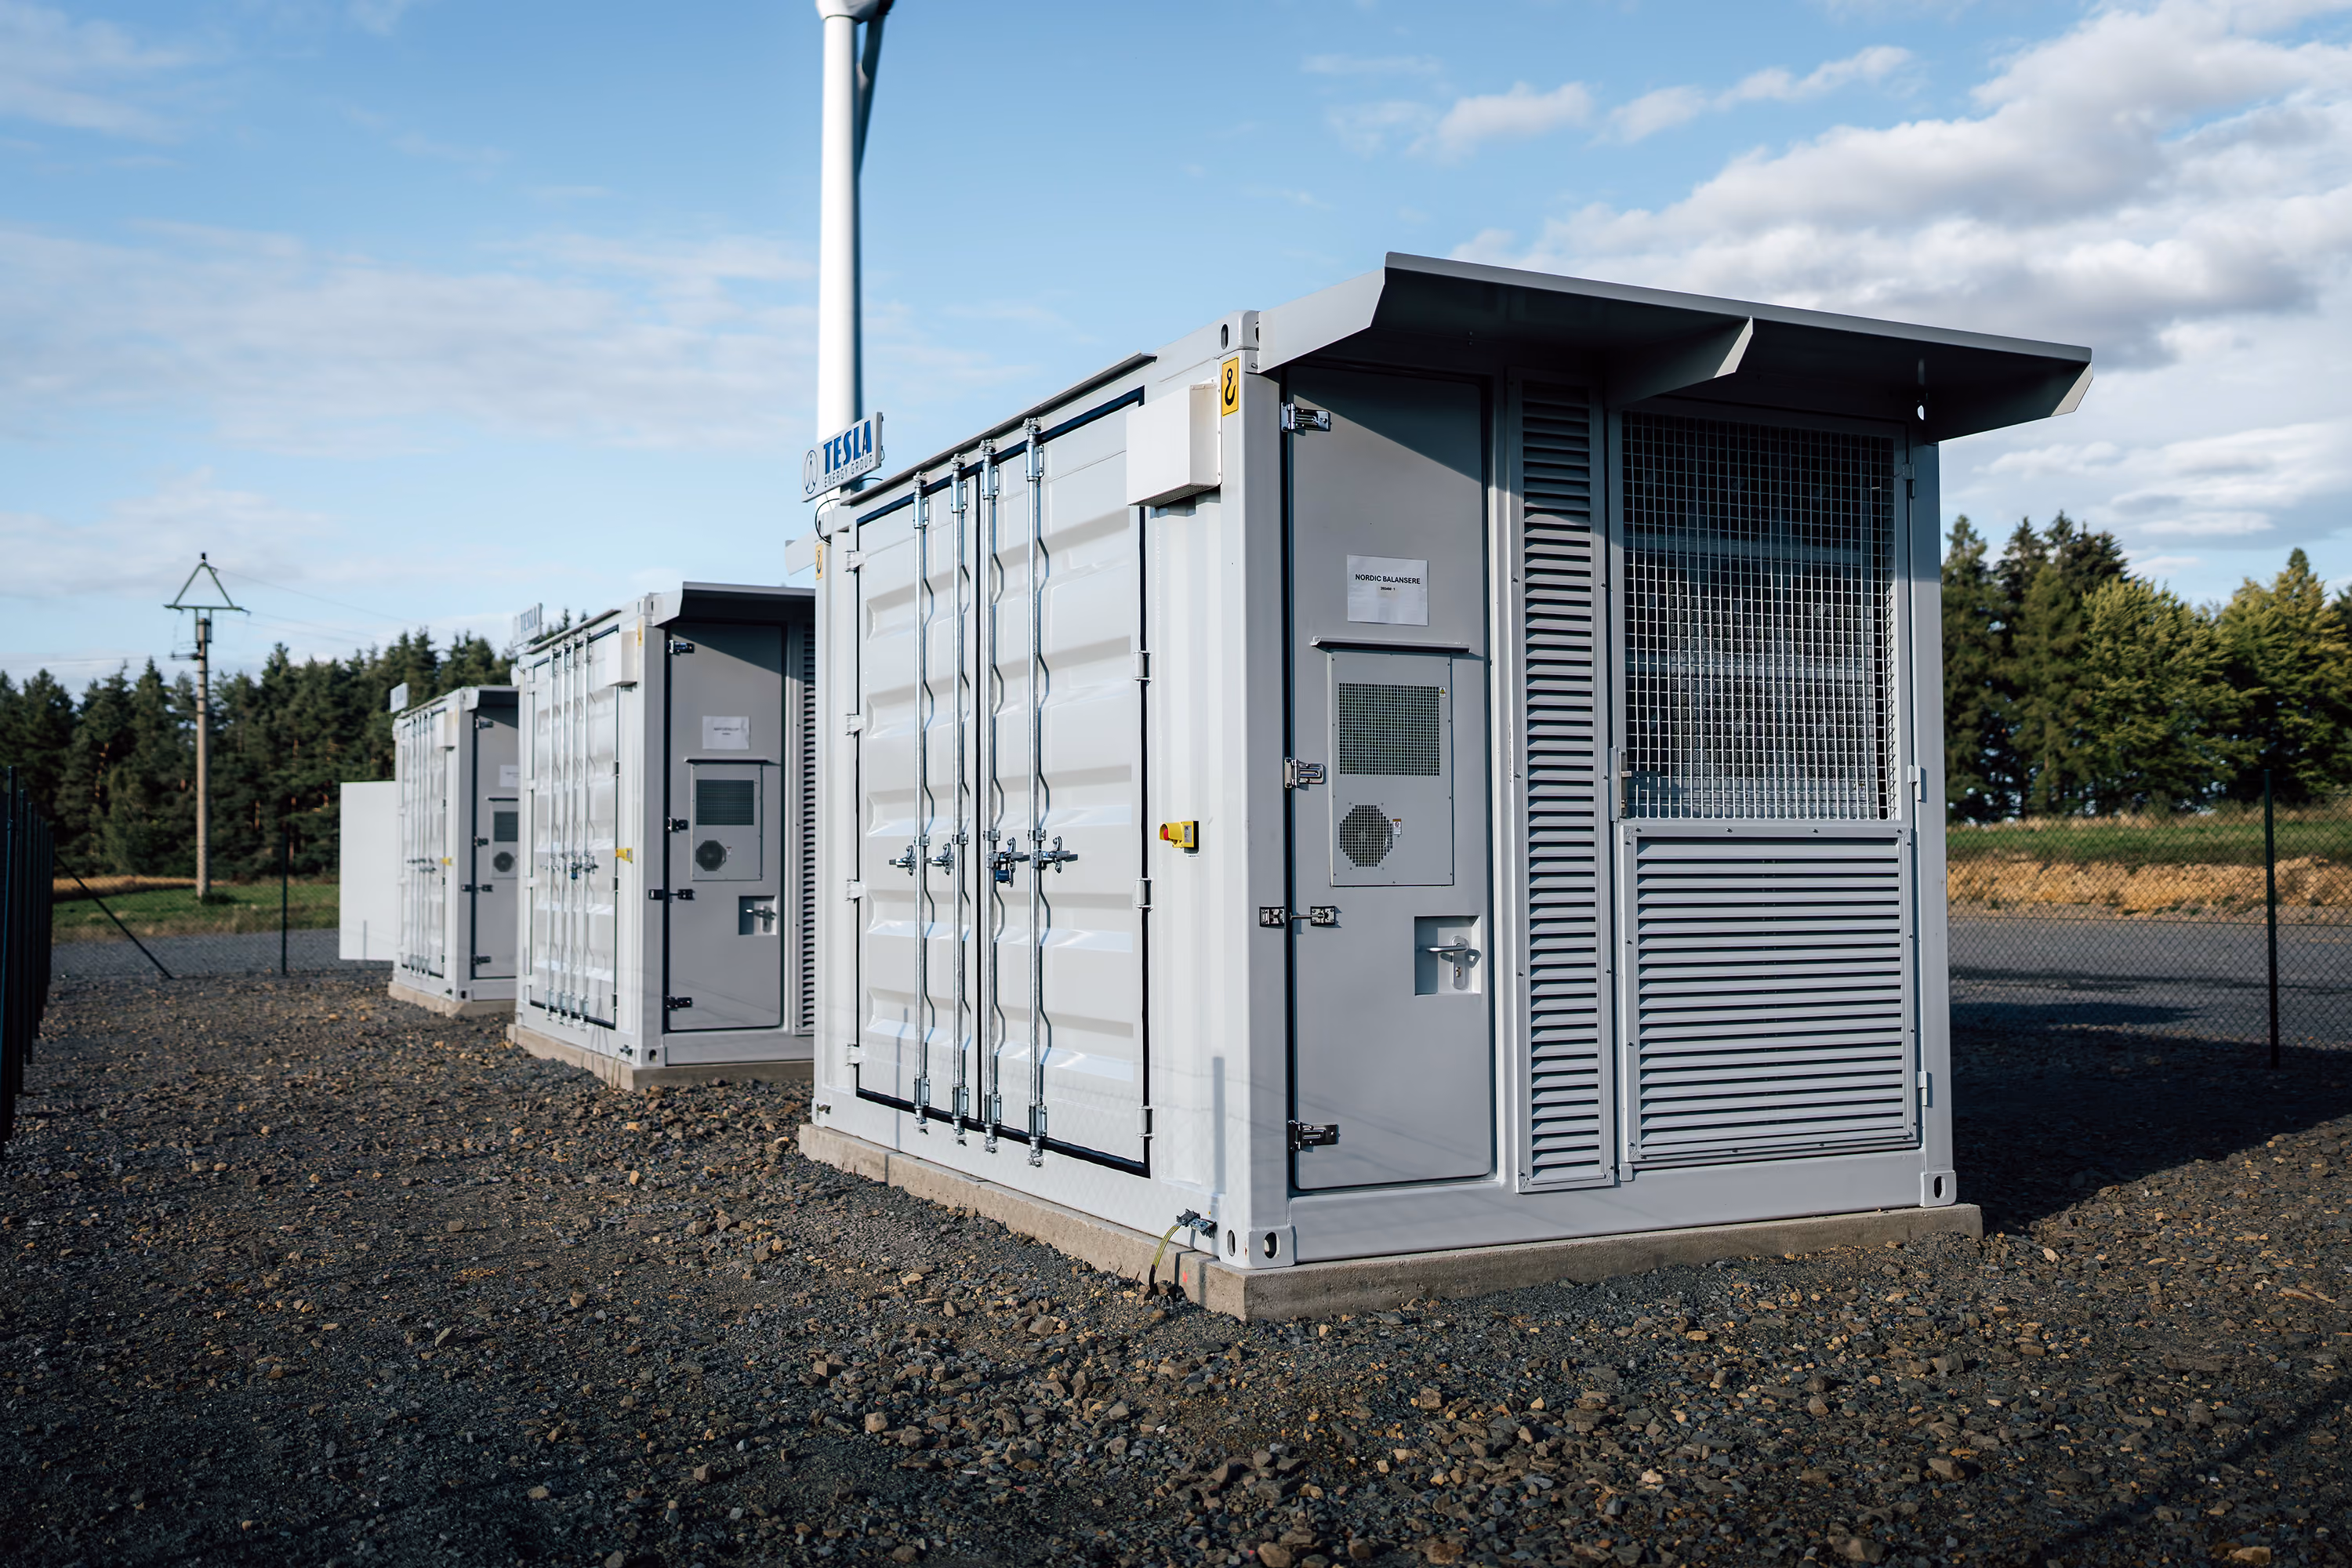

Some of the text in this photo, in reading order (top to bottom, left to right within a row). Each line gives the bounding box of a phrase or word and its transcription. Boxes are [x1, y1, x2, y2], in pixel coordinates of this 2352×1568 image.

[823, 419, 872, 475] TESLA
[824, 454, 873, 488] ENERGY GROUP
[1355, 573, 1421, 585] NORDIC BALANSERE
